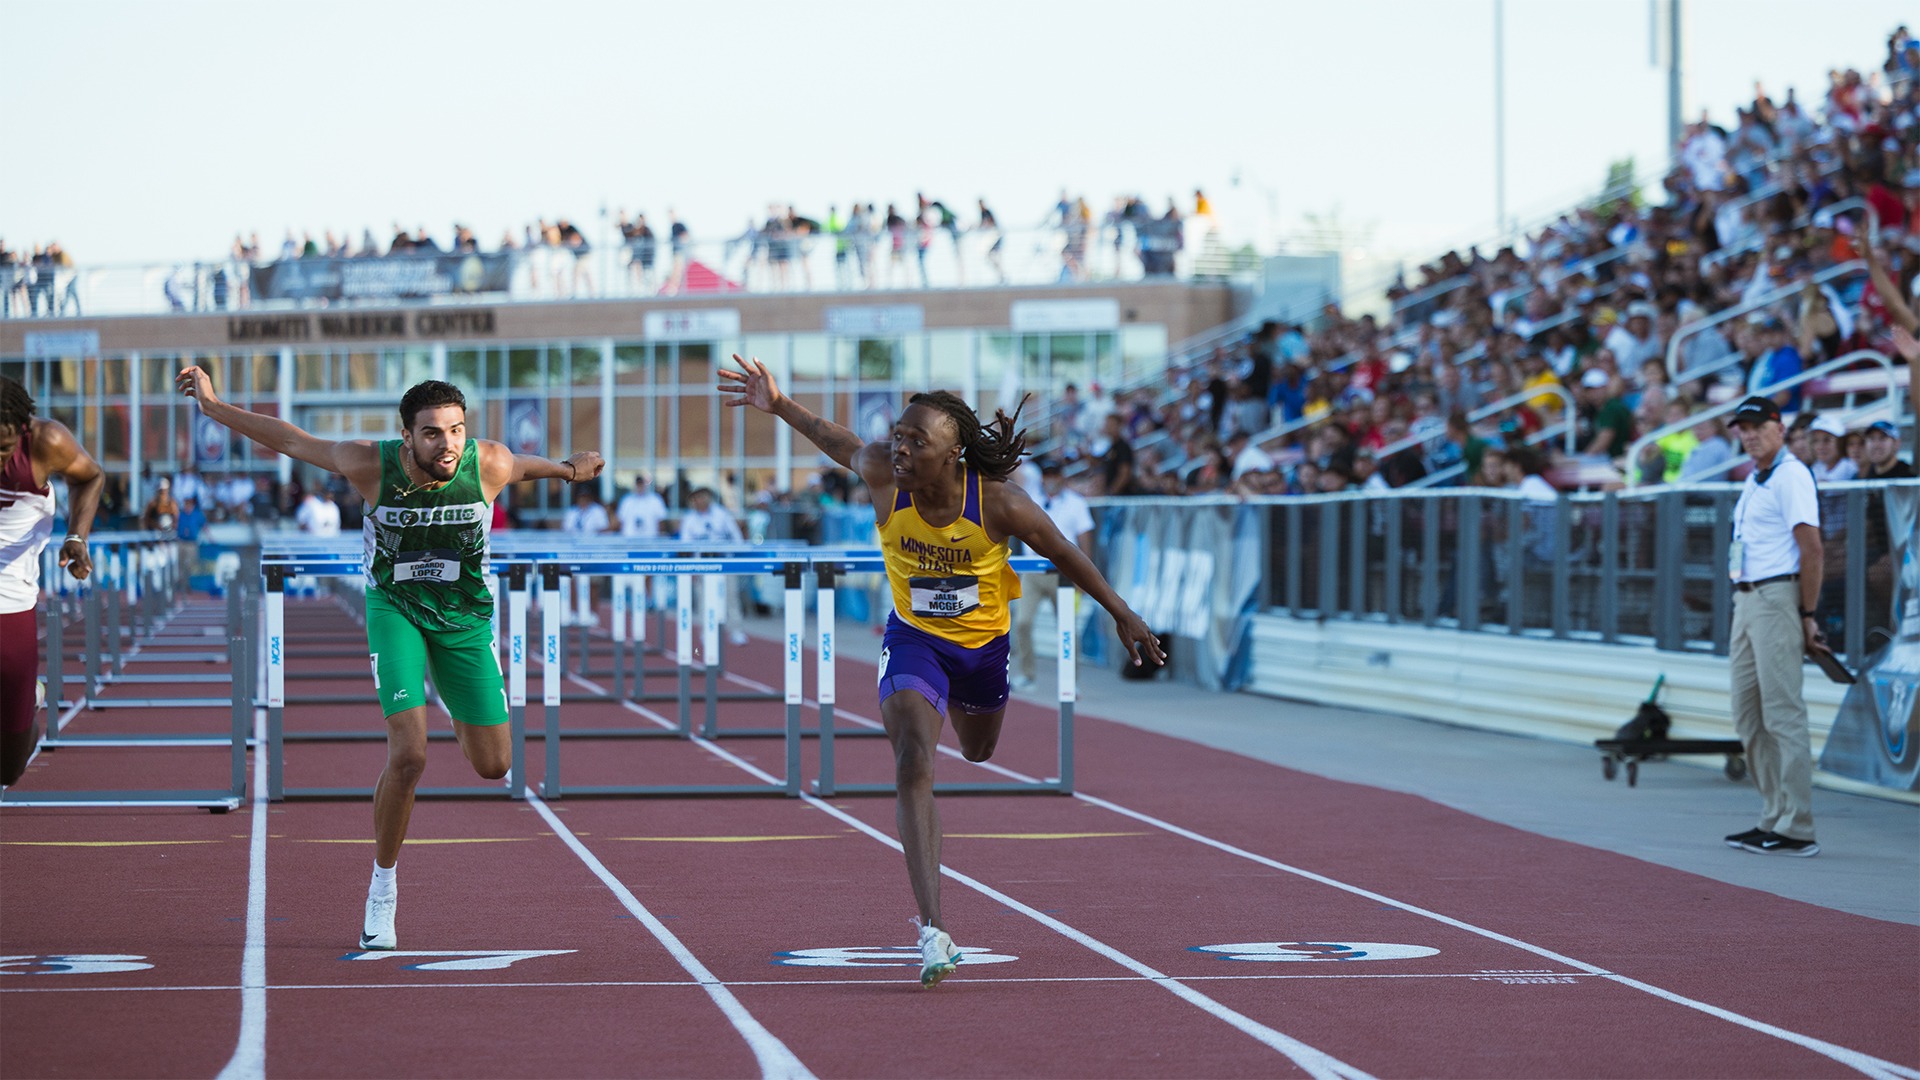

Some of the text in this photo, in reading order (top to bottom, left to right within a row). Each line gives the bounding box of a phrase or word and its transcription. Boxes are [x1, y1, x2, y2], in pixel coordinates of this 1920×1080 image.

[900, 536, 973, 563] MINNESOTA
[410, 562, 445, 570] EDGARDO
[412, 570, 443, 578] LOPEZ
[633, 564, 652, 572] TRACK
[657, 564, 674, 572] FIELD
[674, 564, 723, 572] CHAMPIONSHIPS
[918, 555, 955, 574] STATE
[928, 600, 964, 611] MCGEE
[933, 593, 958, 601] JALEN
[271, 636, 281, 665] NCAA
[513, 635, 522, 664] NCAA
[547, 635, 557, 664] NCAA
[789, 633, 798, 662] NCAA
[822, 633, 831, 662] NCAA
[1062, 631, 1071, 660] NCAA
[336, 949, 580, 971] 7
[769, 946, 1020, 967] 8
[1185, 941, 1442, 962] 9
